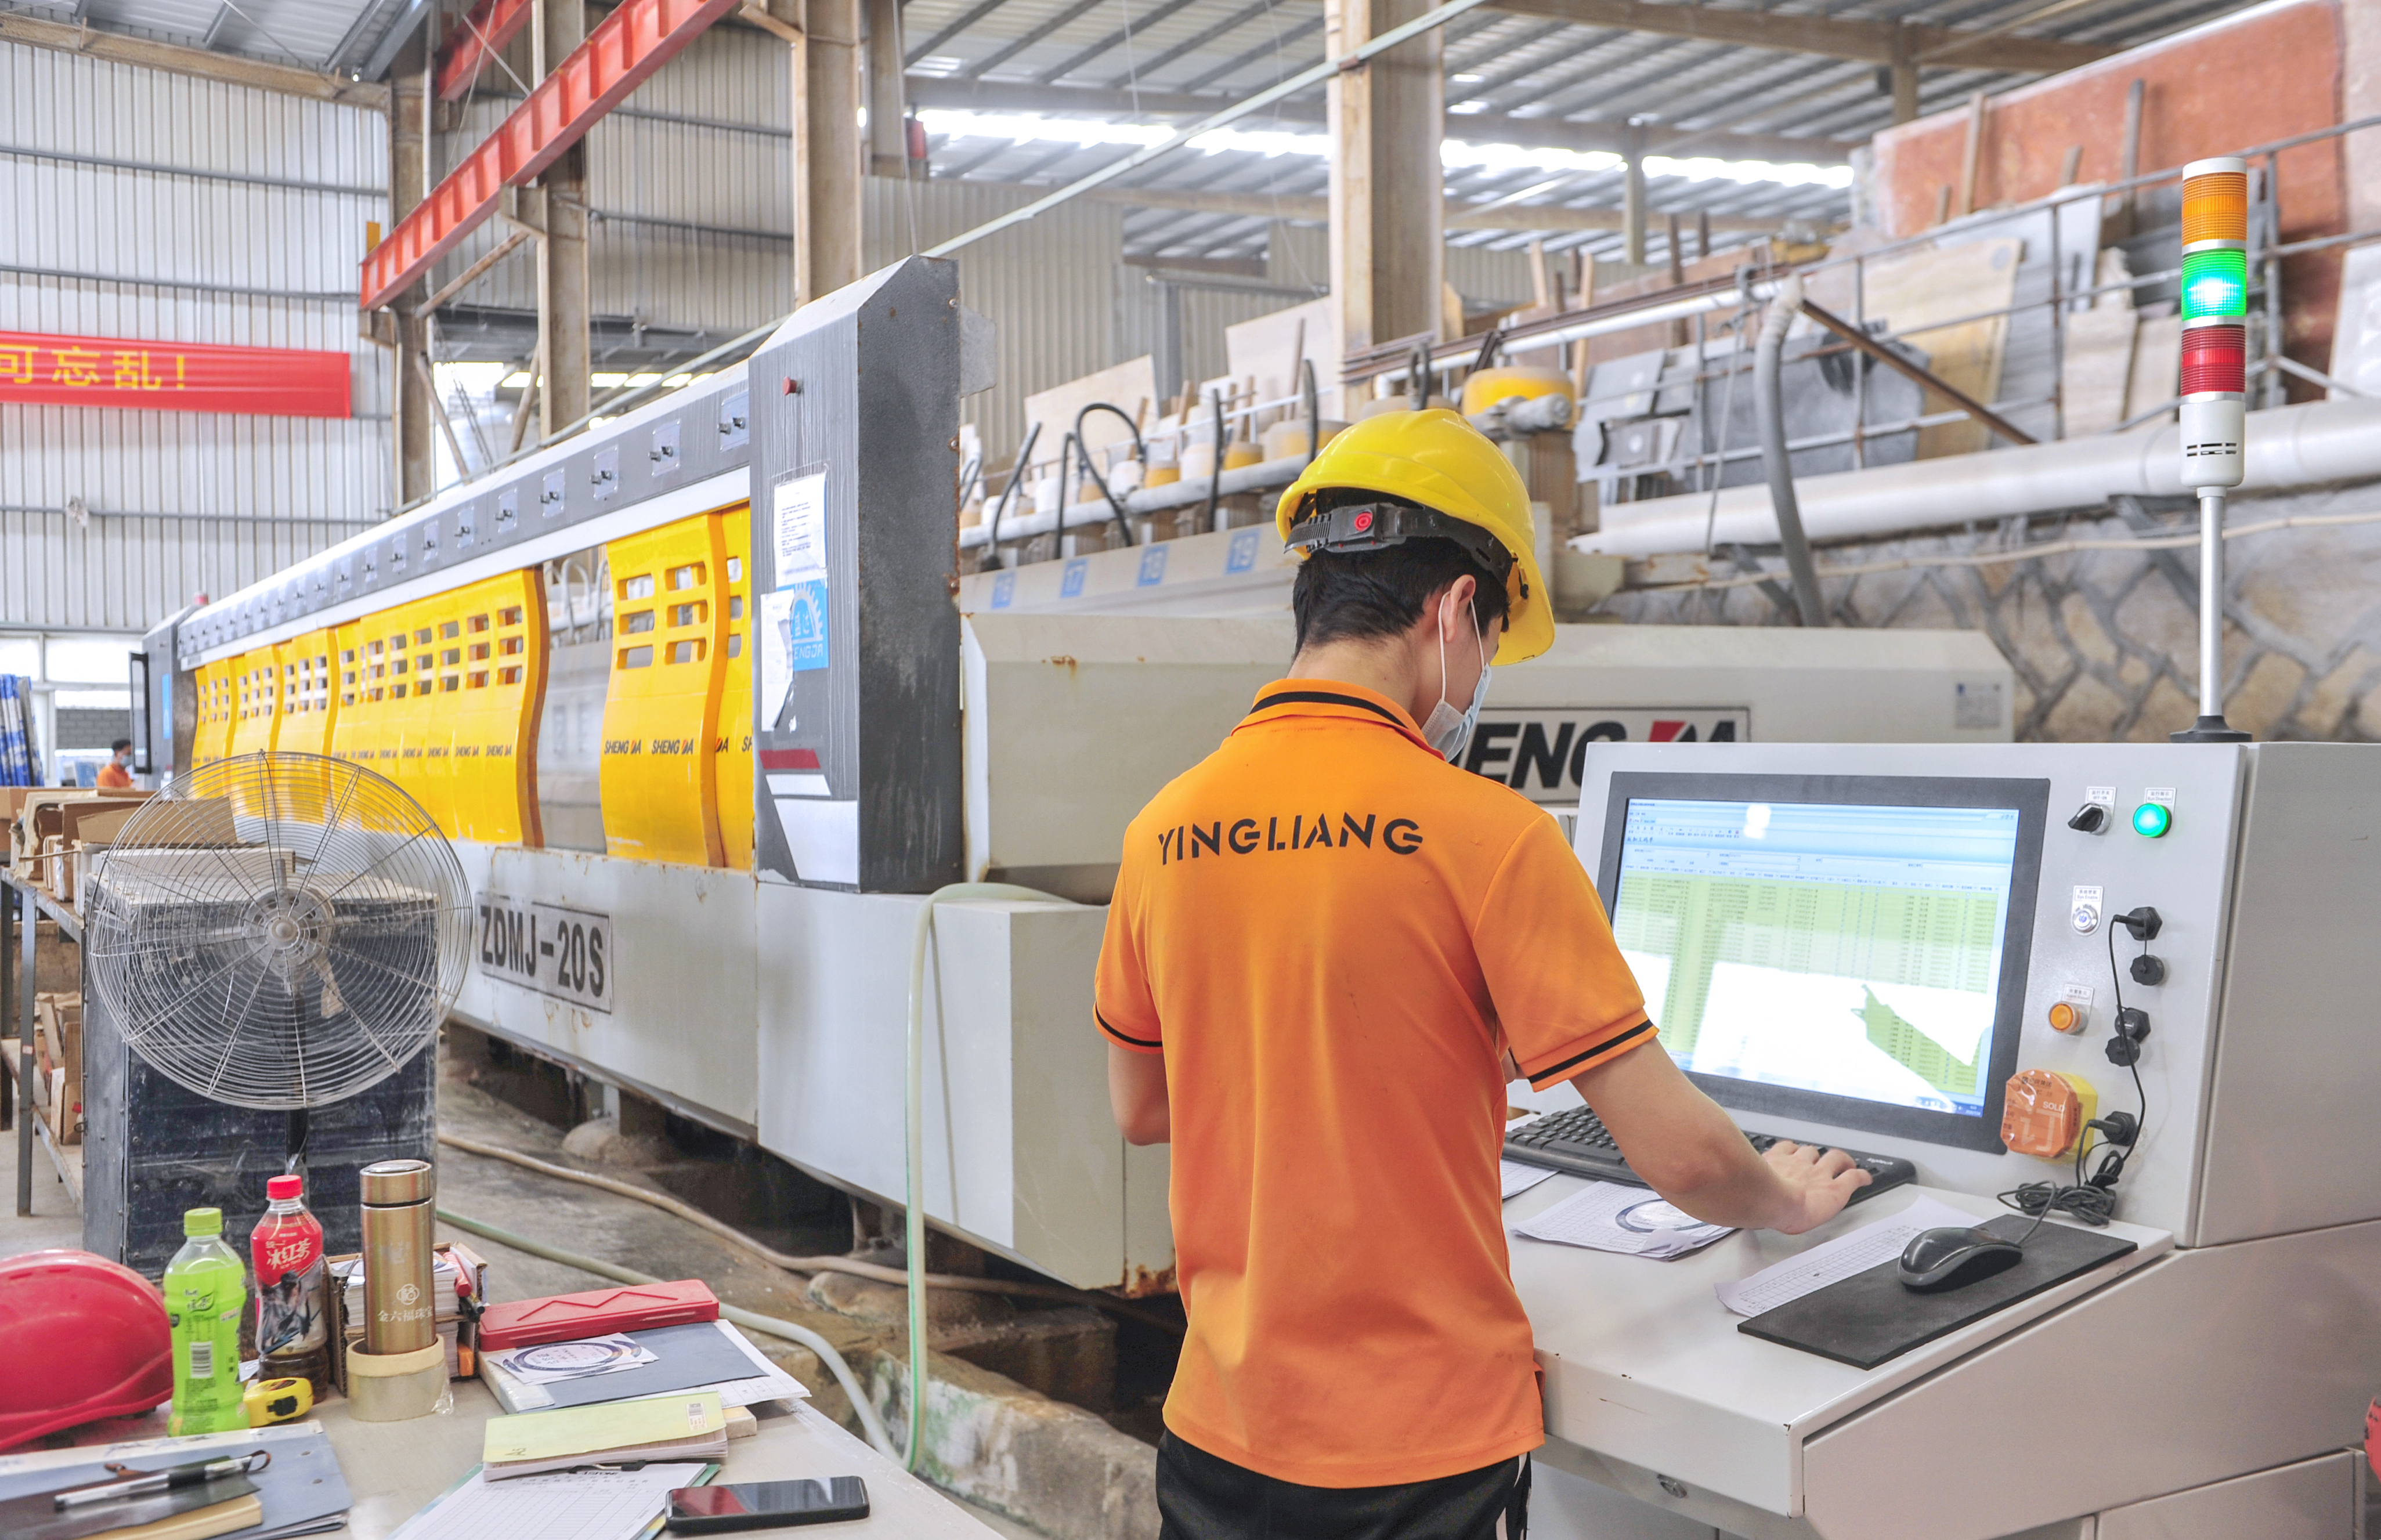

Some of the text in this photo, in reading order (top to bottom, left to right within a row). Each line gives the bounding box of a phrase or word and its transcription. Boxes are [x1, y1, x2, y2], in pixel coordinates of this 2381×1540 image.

[793, 643, 823, 660] ENGDA
[604, 740, 629, 754] SHENG
[652, 739, 680, 754] SHENG
[1158, 812, 1423, 865] YINGLIANG
[480, 905, 604, 997] ZDMJ-20S
[2043, 1101, 2065, 1112] SOLD
[377, 1305, 433, 1322] 金六福珠宝
